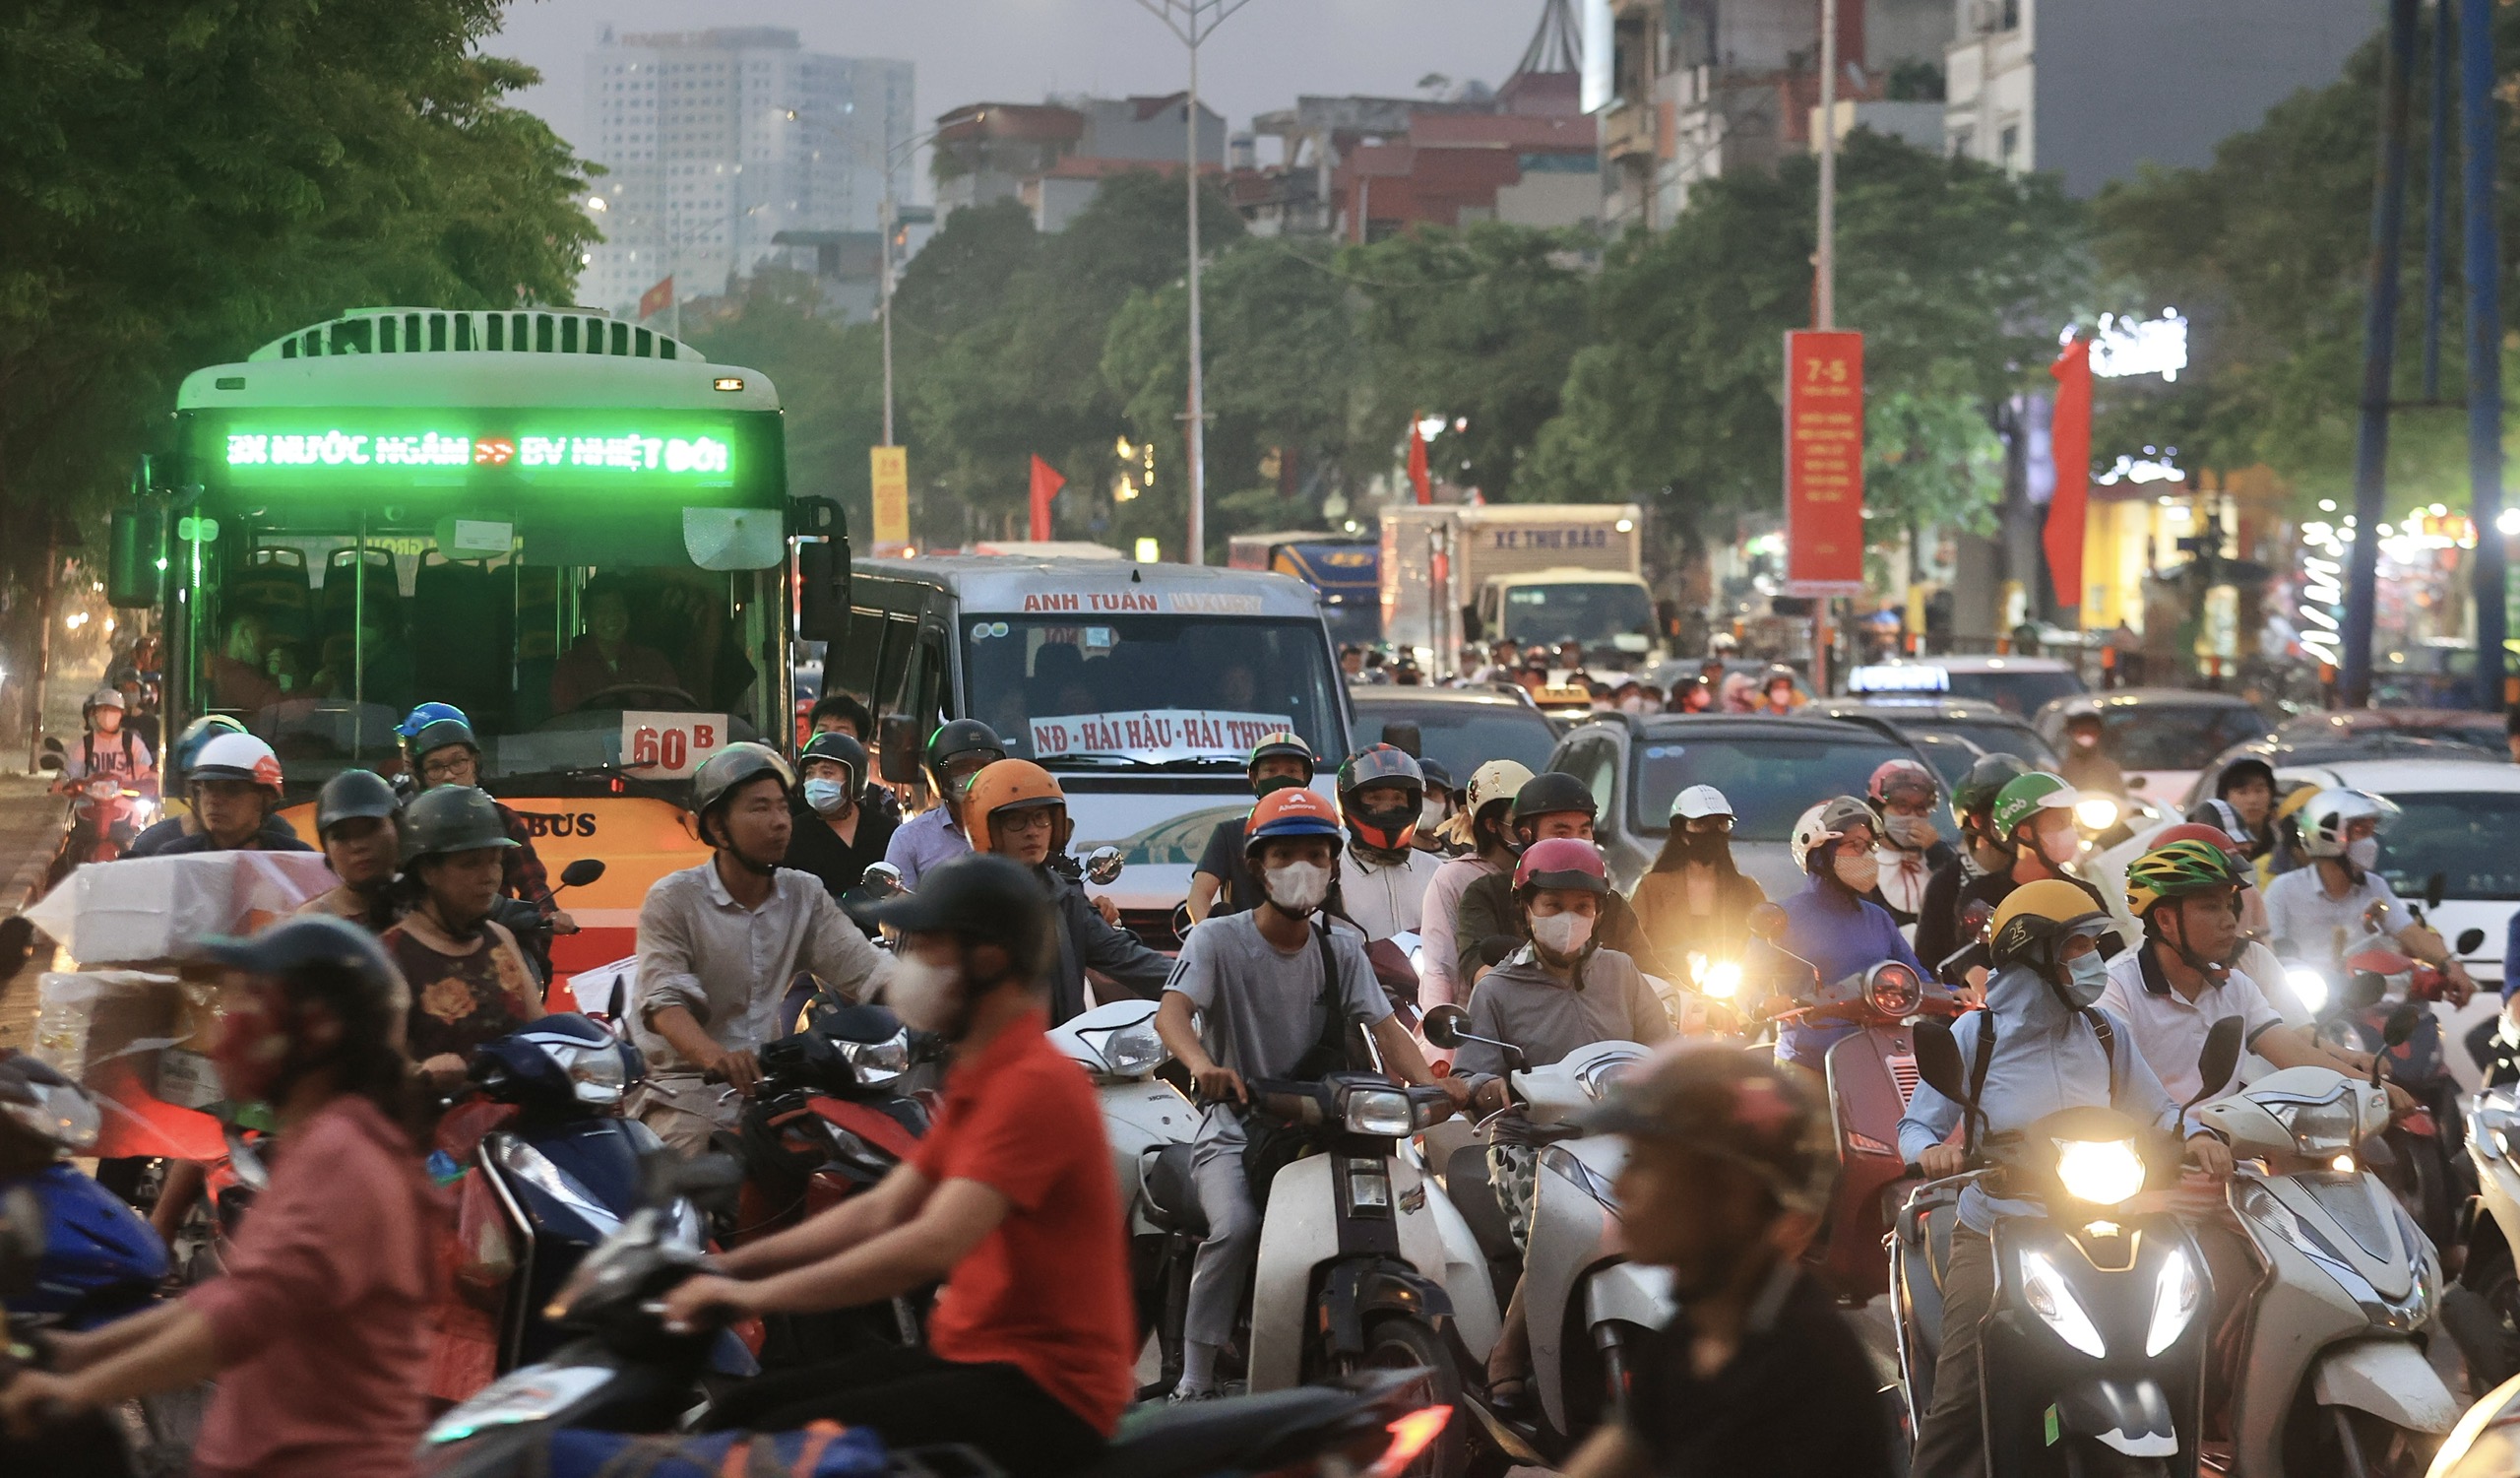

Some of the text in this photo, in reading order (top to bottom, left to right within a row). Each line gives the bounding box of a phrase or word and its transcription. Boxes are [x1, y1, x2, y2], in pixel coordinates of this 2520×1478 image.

[1495, 531, 1518, 549] XE
[1024, 593, 1079, 611] ANH
[1035, 725, 1068, 753] NĐ
[1082, 714, 1123, 751] HẢI
[1125, 712, 1172, 753] HẬU
[1183, 711, 1225, 749] HẢI
[1278, 803, 1317, 812] Ahamove
[2000, 799, 2028, 820] Grab
[2009, 925, 2027, 940] 25
